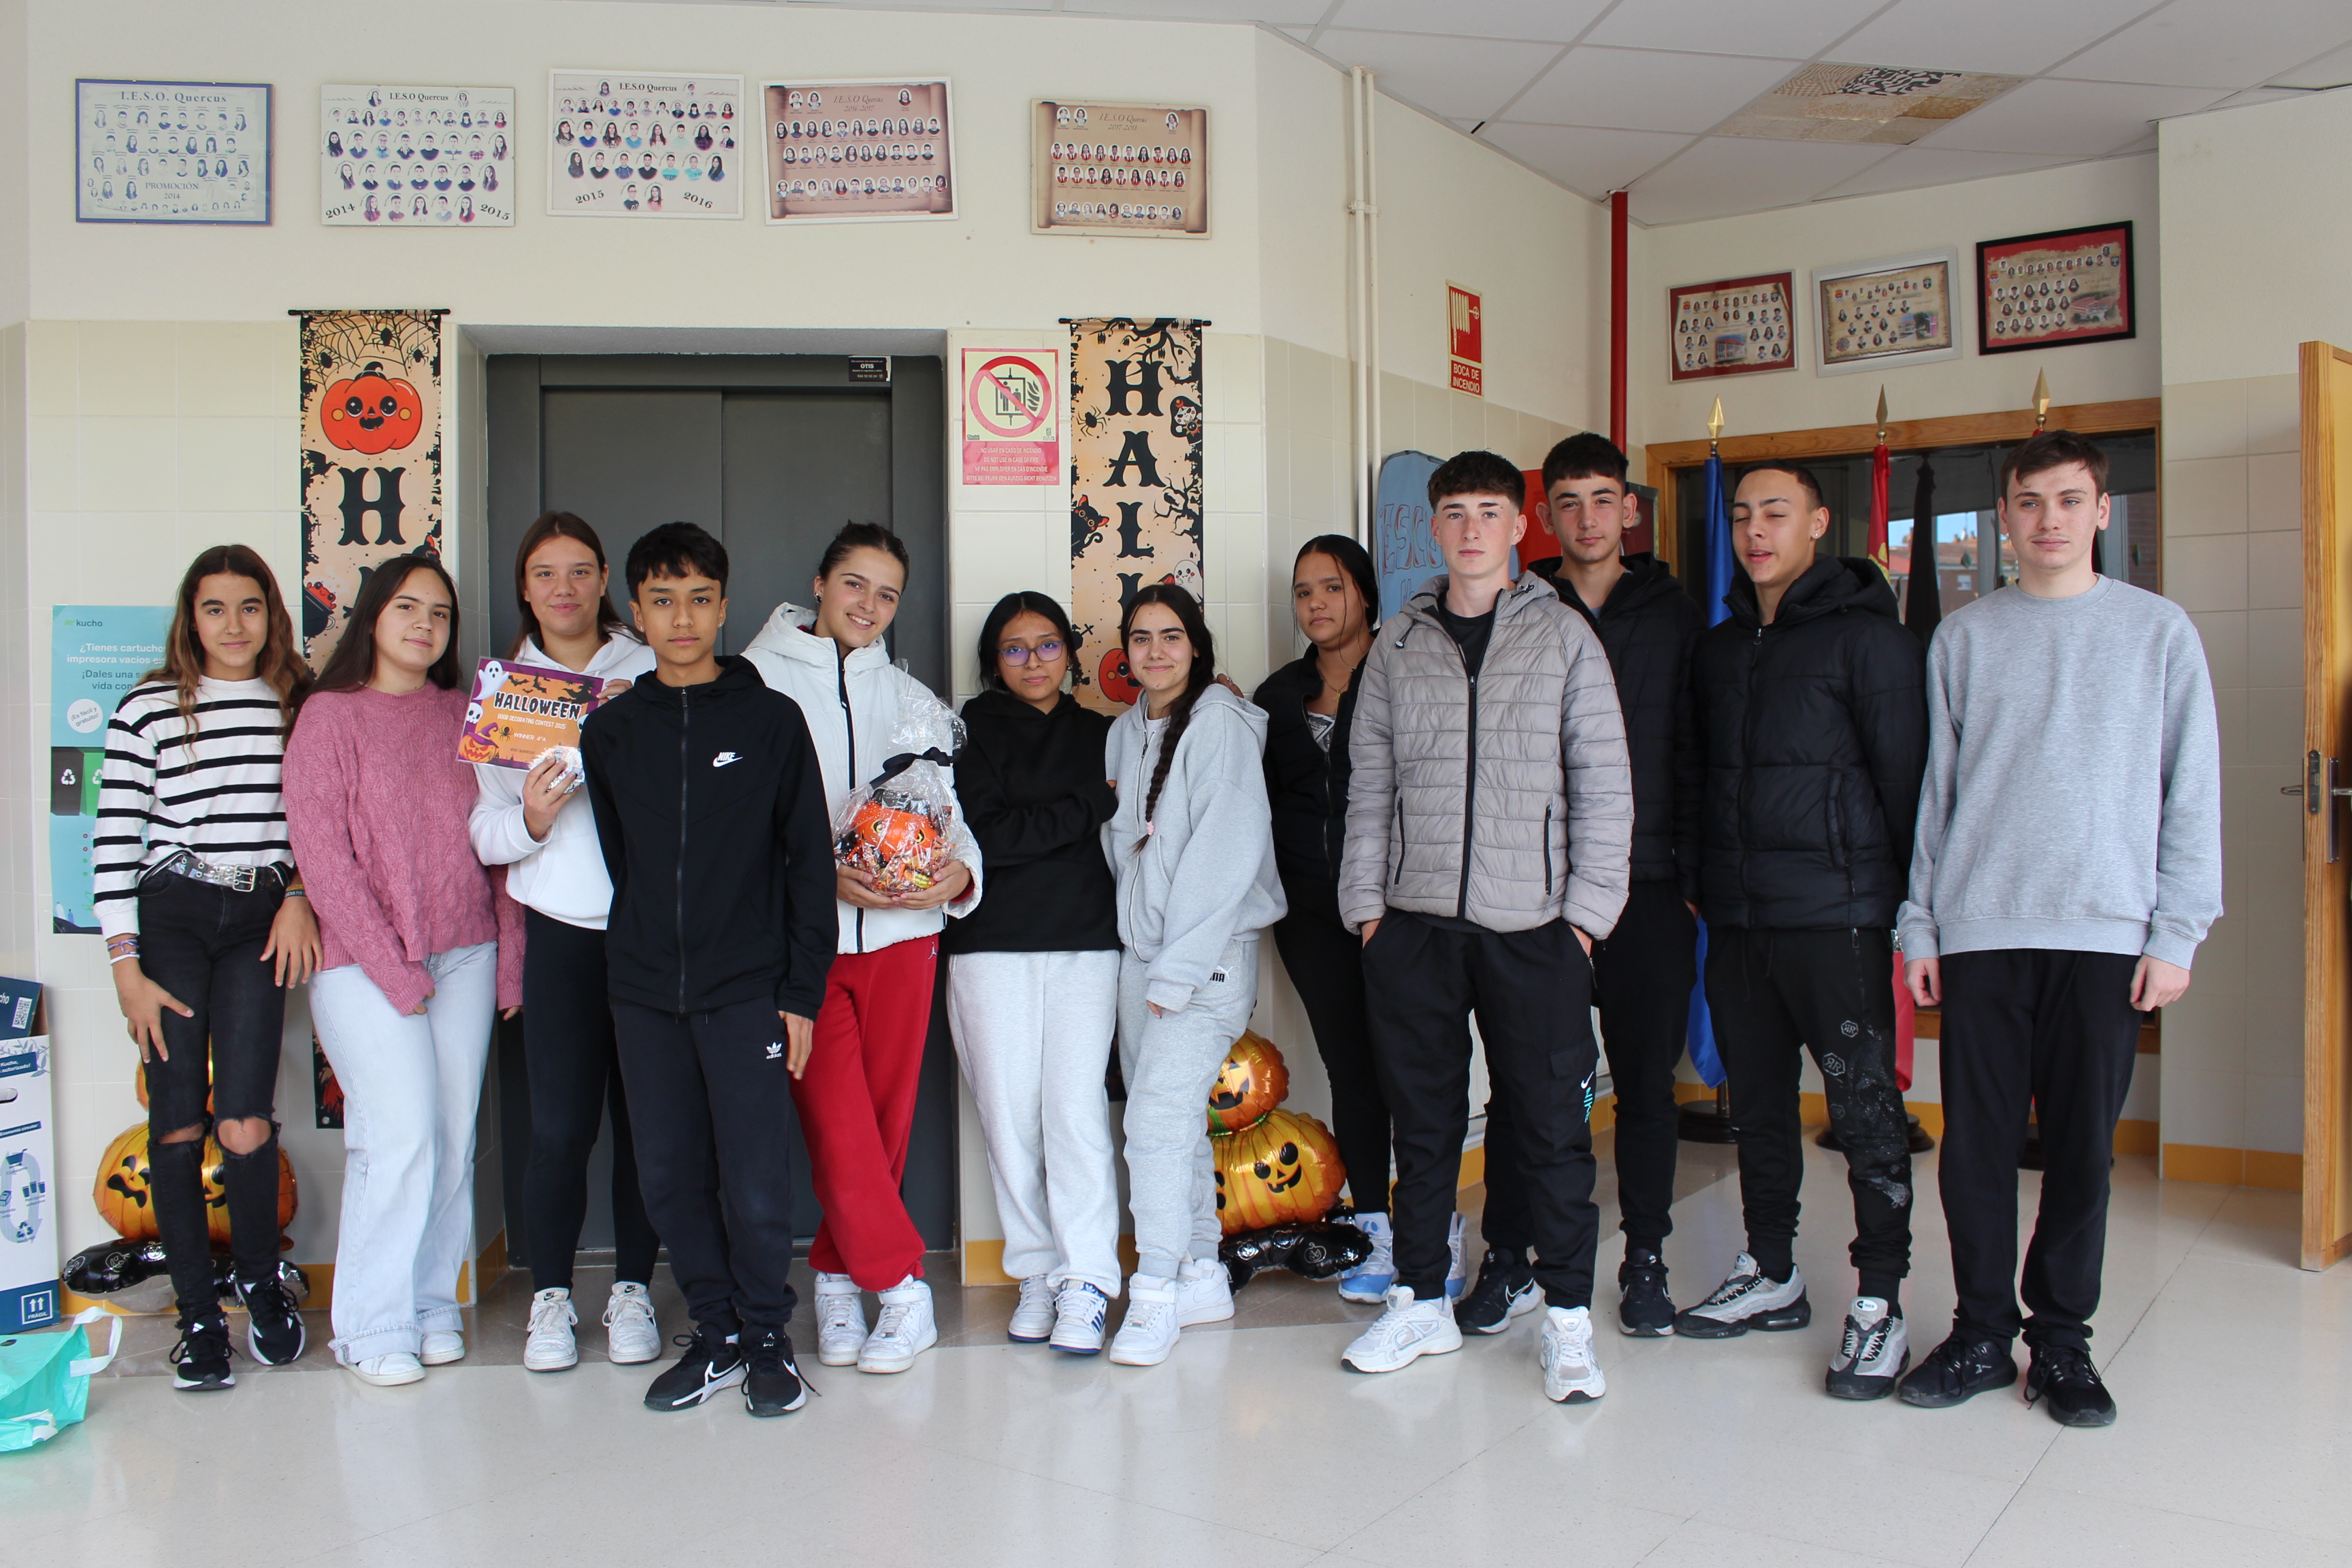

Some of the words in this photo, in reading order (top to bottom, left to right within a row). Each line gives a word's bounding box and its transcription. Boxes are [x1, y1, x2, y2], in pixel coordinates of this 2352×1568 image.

[619, 82, 645, 91] I.E.S.O
[647, 83, 677, 93] Quercus
[120, 91, 170, 101] I.E.S.O.
[174, 92, 227, 103] Quercus
[389, 93, 416, 101] I.E.S.O
[418, 93, 449, 102] Quercus
[862, 95, 883, 103] Quercus
[1126, 114, 1148, 123] Quercus
[145, 182, 199, 191] PROMOCIÓN
[574, 189, 605, 205] 2015
[683, 191, 713, 209] 2016
[325, 202, 356, 219] 2014
[480, 203, 511, 222] 2015
[1454, 363, 1470, 378] BOCA
[1471, 369, 1480, 380] DE
[1453, 376, 1480, 393] INCENDIO
[76, 619, 103, 627] kucho
[80, 643, 118, 653] ¿Tienes
[120, 644, 166, 653] cartucho
[67, 655, 117, 665] impresora
[119, 655, 150, 664] vacíos
[82, 670, 113, 679] ¡Dales
[92, 682, 112, 690] vida
[493, 691, 582, 721] HALLOWEEN
[80, 708, 93, 716] fácil
[76, 713, 99, 727] gratuito!
[508, 715, 535, 725] DECORATING
[535, 719, 555, 728] CONTEST
[717, 751, 736, 761] NIKE
[0, 992, 10, 1004] cho
[0, 1060, 19, 1068] Kucho,
[1, 1063, 31, 1073] autorizado!
